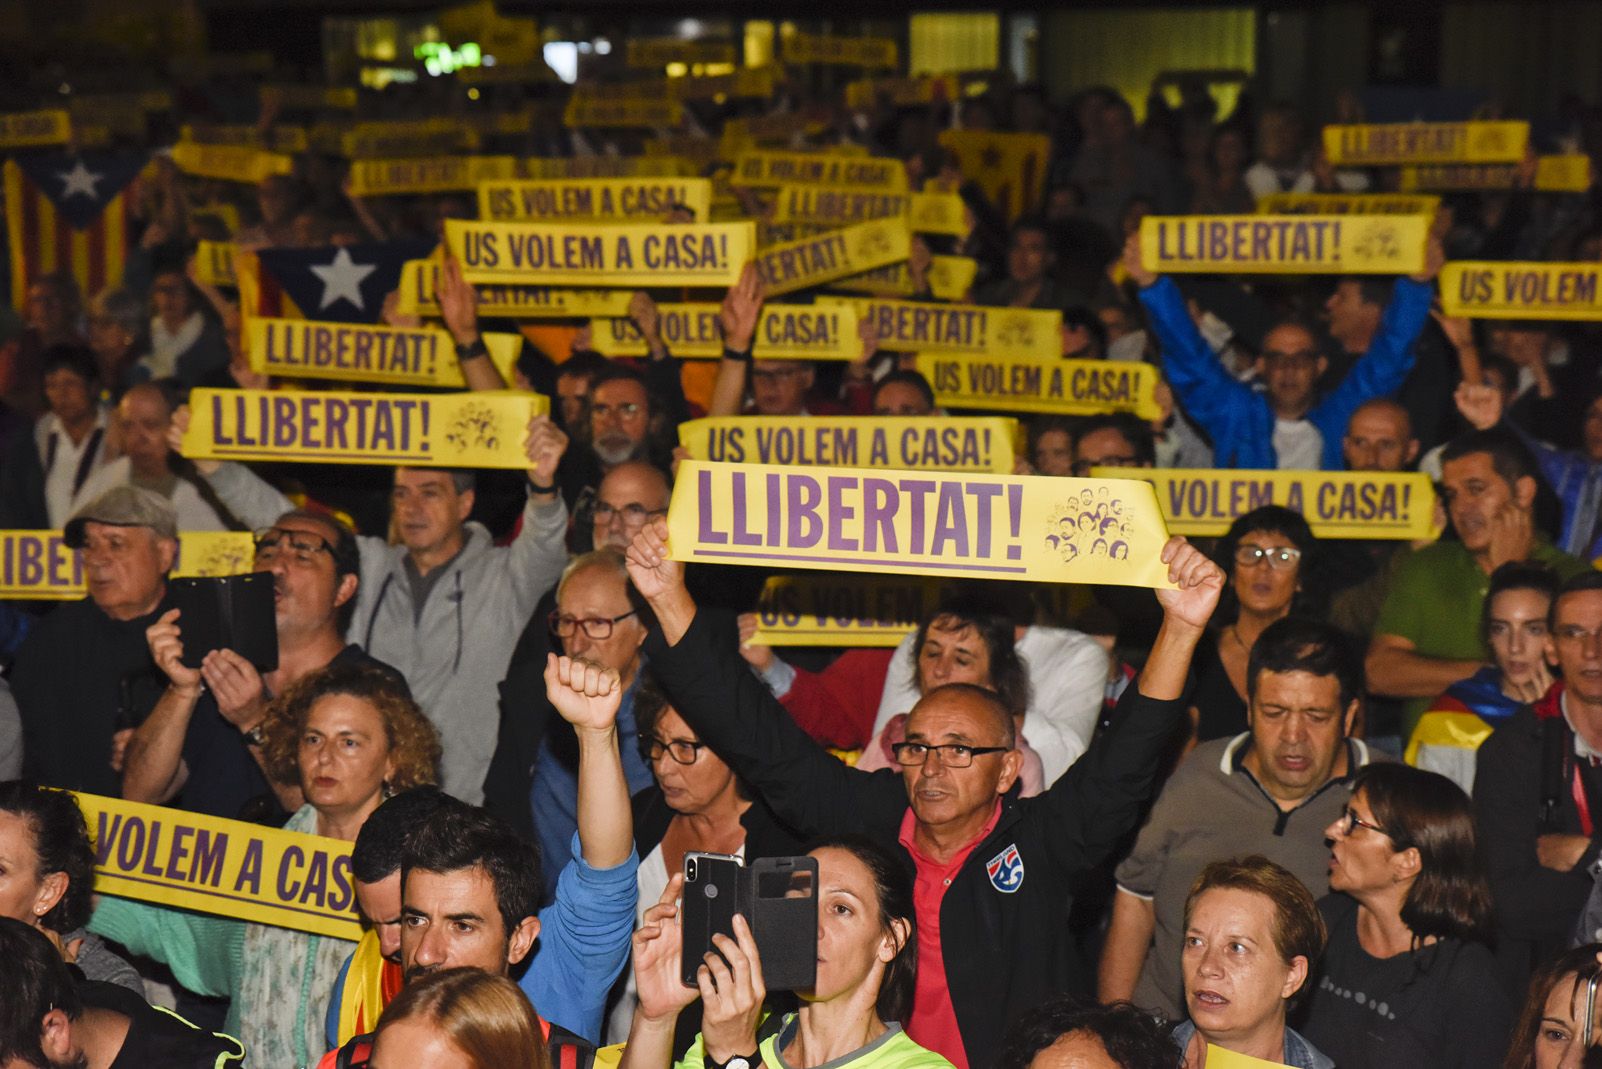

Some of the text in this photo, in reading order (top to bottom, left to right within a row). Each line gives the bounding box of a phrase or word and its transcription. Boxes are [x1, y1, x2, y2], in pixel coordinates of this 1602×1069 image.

[489, 188, 516, 218] US
[521, 188, 592, 218] VOLEM
[602, 188, 614, 215] A
[465, 231, 728, 270] US VOLEM A CASA!
[1158, 222, 1342, 261] LLIBERTAT!
[1459, 270, 1597, 307] US VOLEM
[766, 313, 839, 345] CASA!
[266, 324, 437, 375] LLIBERTAT!
[934, 363, 1141, 402] US VOLEM A CASA!
[212, 395, 431, 451] LLIBERTAT!
[709, 426, 992, 467] US VOLEM A CASA!
[697, 469, 1024, 561] LLIBERTAT!
[1169, 479, 1273, 518] VOLEM
[1317, 482, 1412, 521] CASA!
[96, 811, 360, 914] VOLEM A CAS
